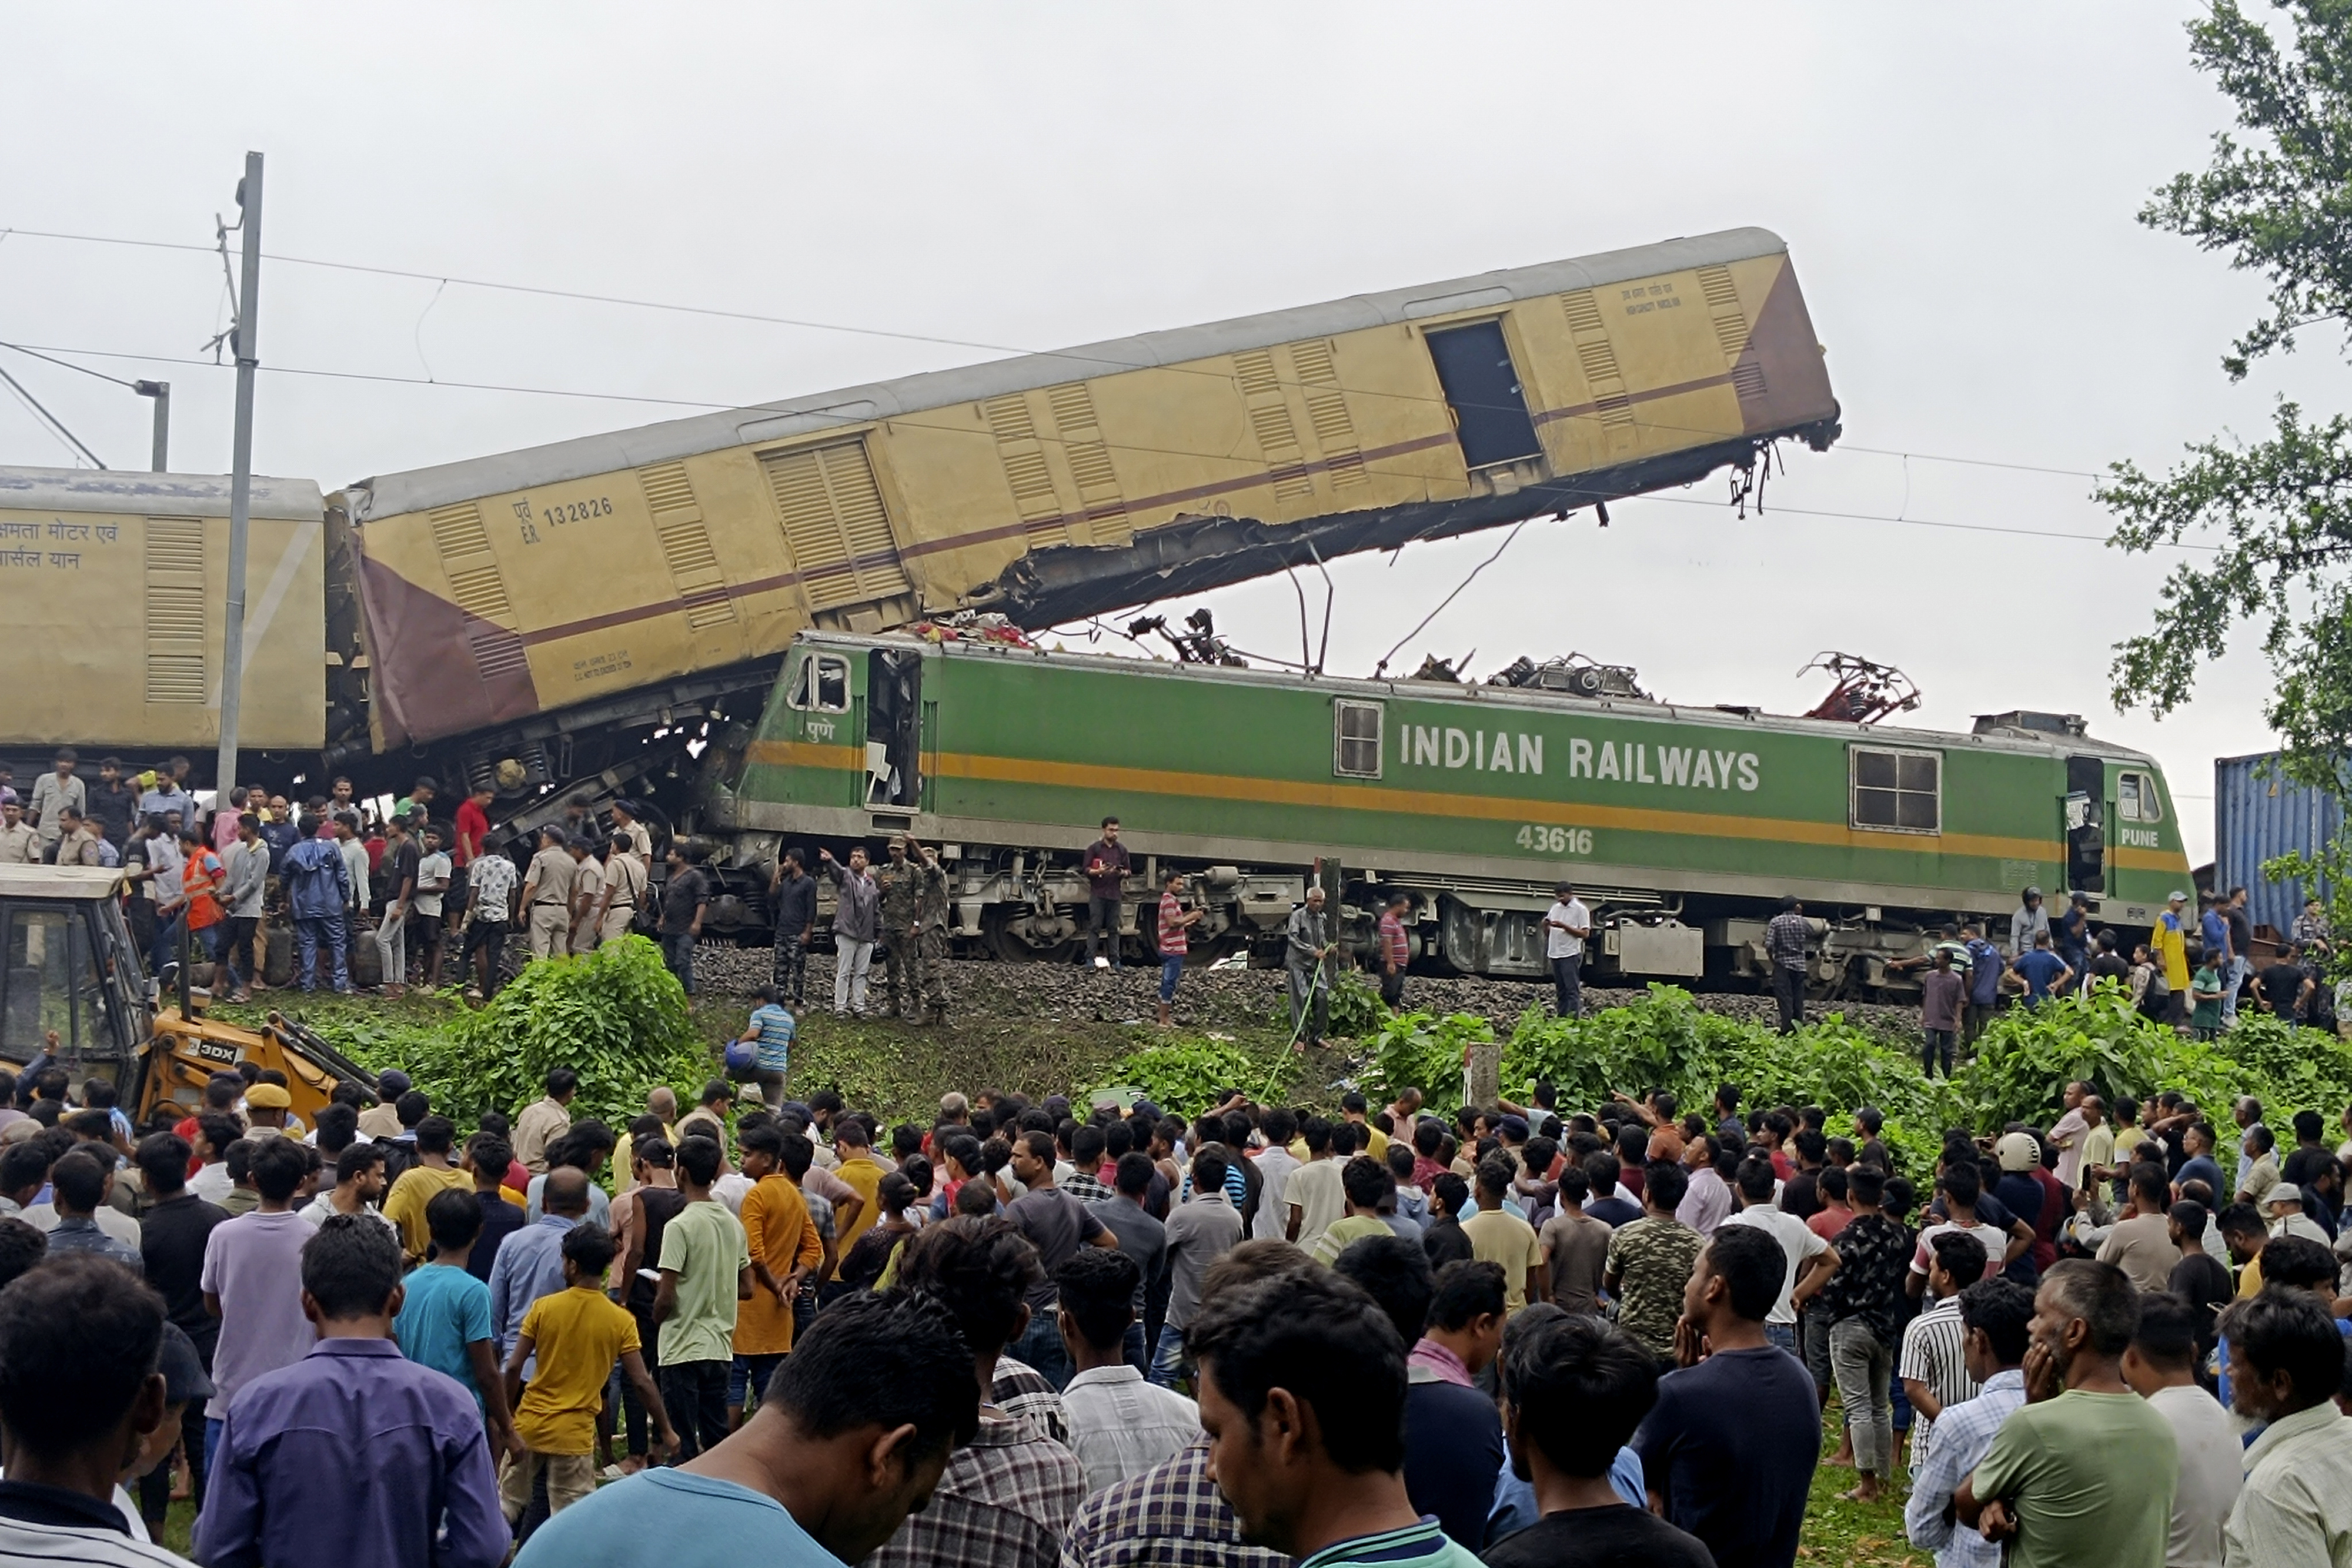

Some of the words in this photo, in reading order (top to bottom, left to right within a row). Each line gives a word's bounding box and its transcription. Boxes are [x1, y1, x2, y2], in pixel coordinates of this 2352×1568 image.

[544, 497, 612, 527] 132826
[48, 518, 89, 540] मोटर
[49, 553, 81, 569] यान
[807, 718, 836, 743] पुणे
[1401, 724, 1542, 774] INDIAN
[1569, 738, 1760, 791] RAILWAYS
[1516, 825, 1593, 854] 43616
[2122, 828, 2159, 847] PUNE
[201, 1045, 235, 1061] 3DX
